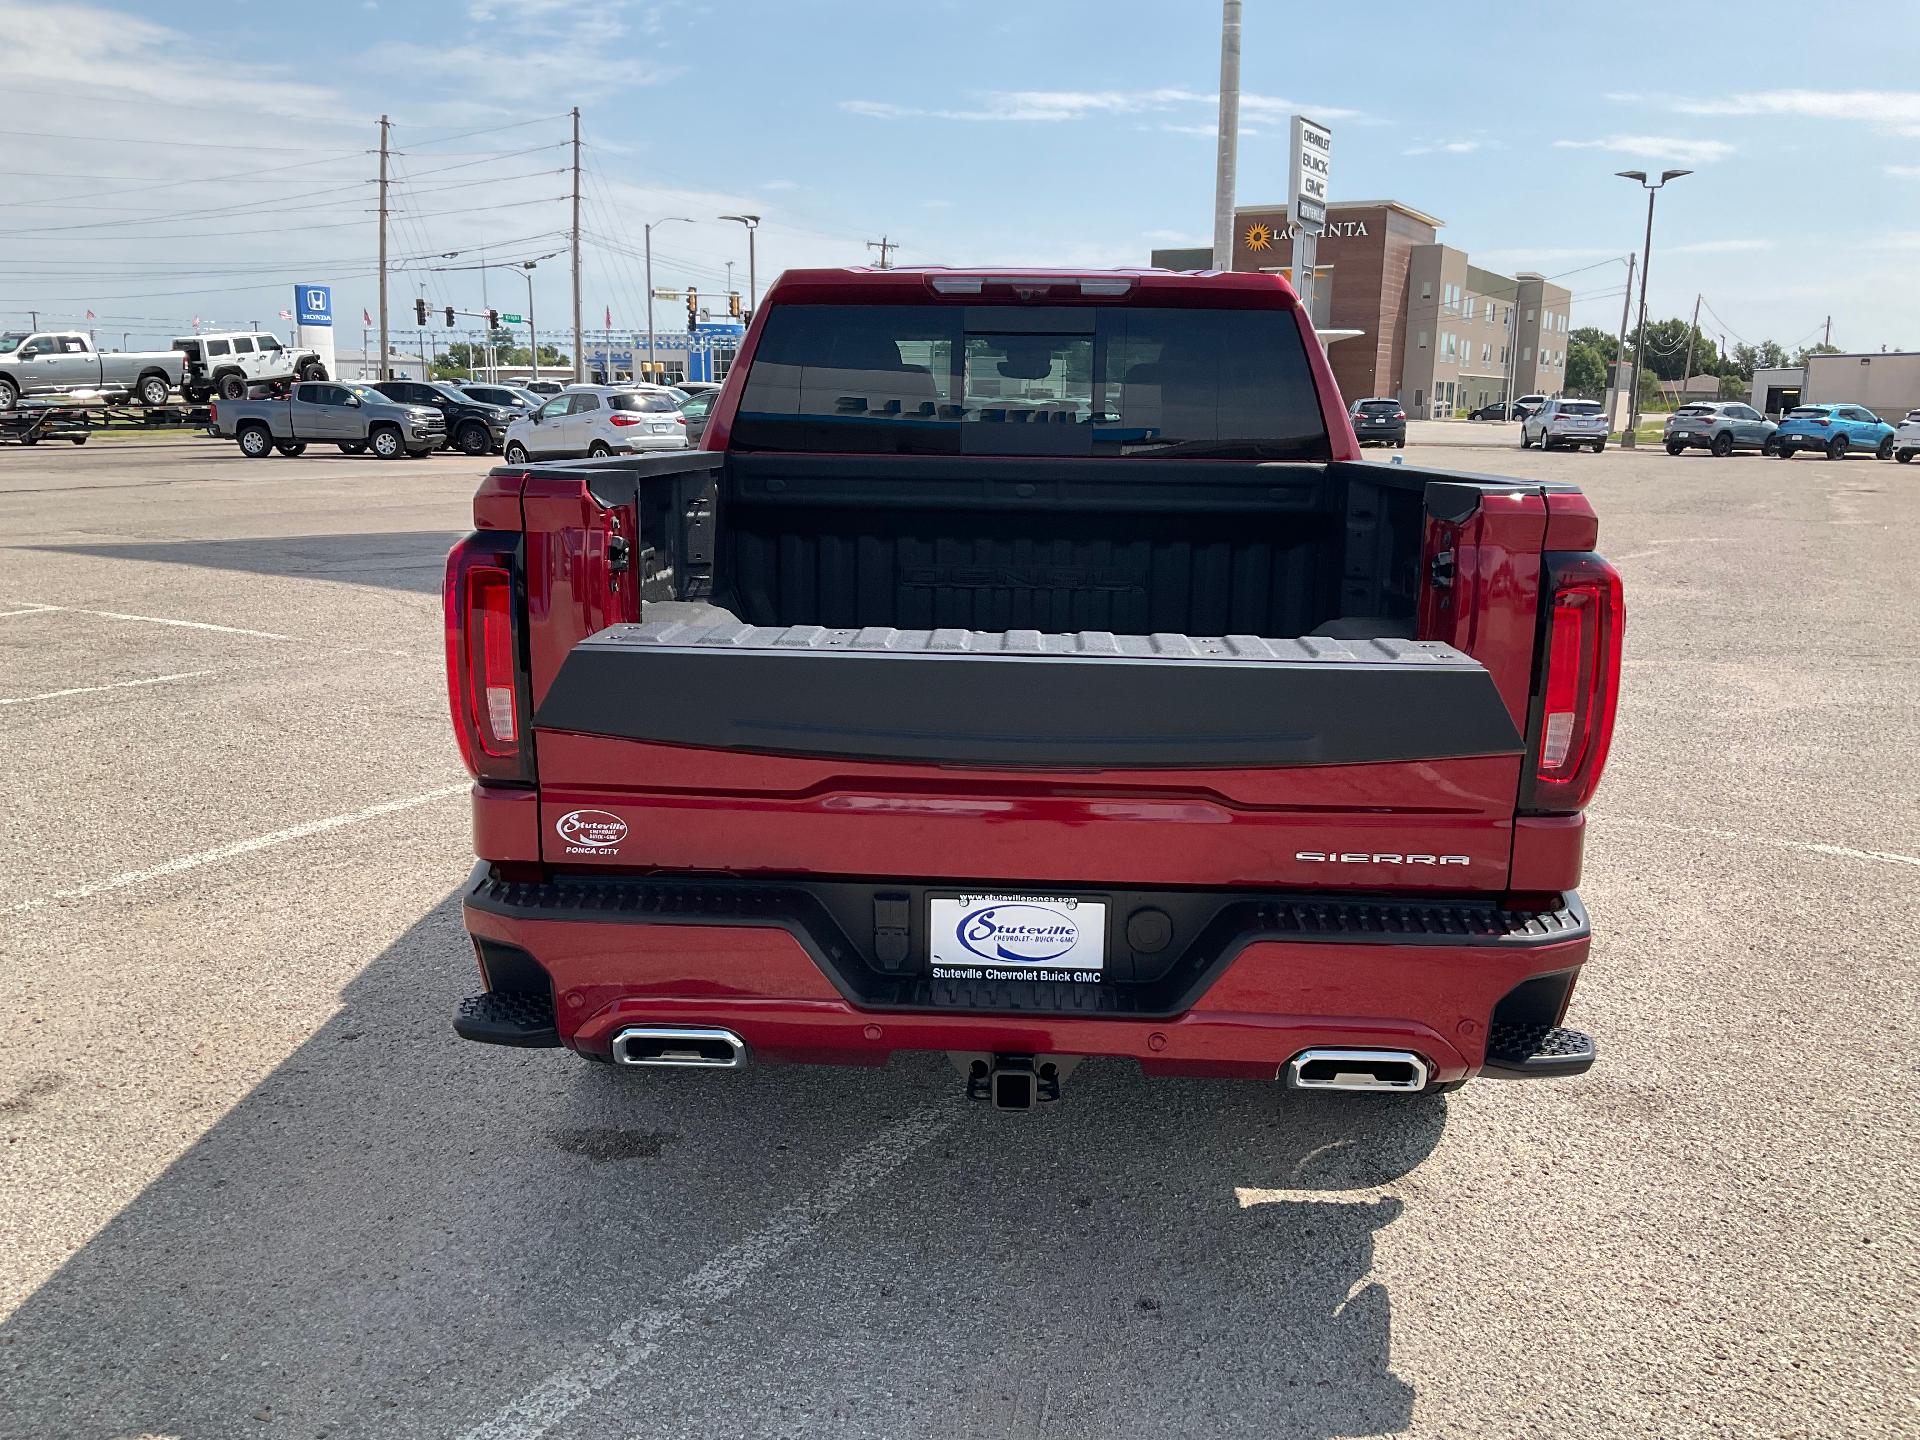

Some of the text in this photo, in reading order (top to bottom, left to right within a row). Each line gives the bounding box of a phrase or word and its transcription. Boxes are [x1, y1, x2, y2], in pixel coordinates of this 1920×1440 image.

[1304, 130, 1330, 150] CHEVROLET
[1302, 153, 1329, 175] BUICK
[1305, 177, 1325, 198] GMC
[1273, 221, 1369, 240] LA INTA
[302, 313, 332, 321] HONDA
[563, 813, 626, 832] Stuteville
[565, 846, 620, 855] PONCA CITY
[1295, 851, 1470, 866] SIERRA
[968, 910, 1076, 941] Stuteville
[933, 967, 1101, 983] Stuteville Chevrolet Buick GMC
